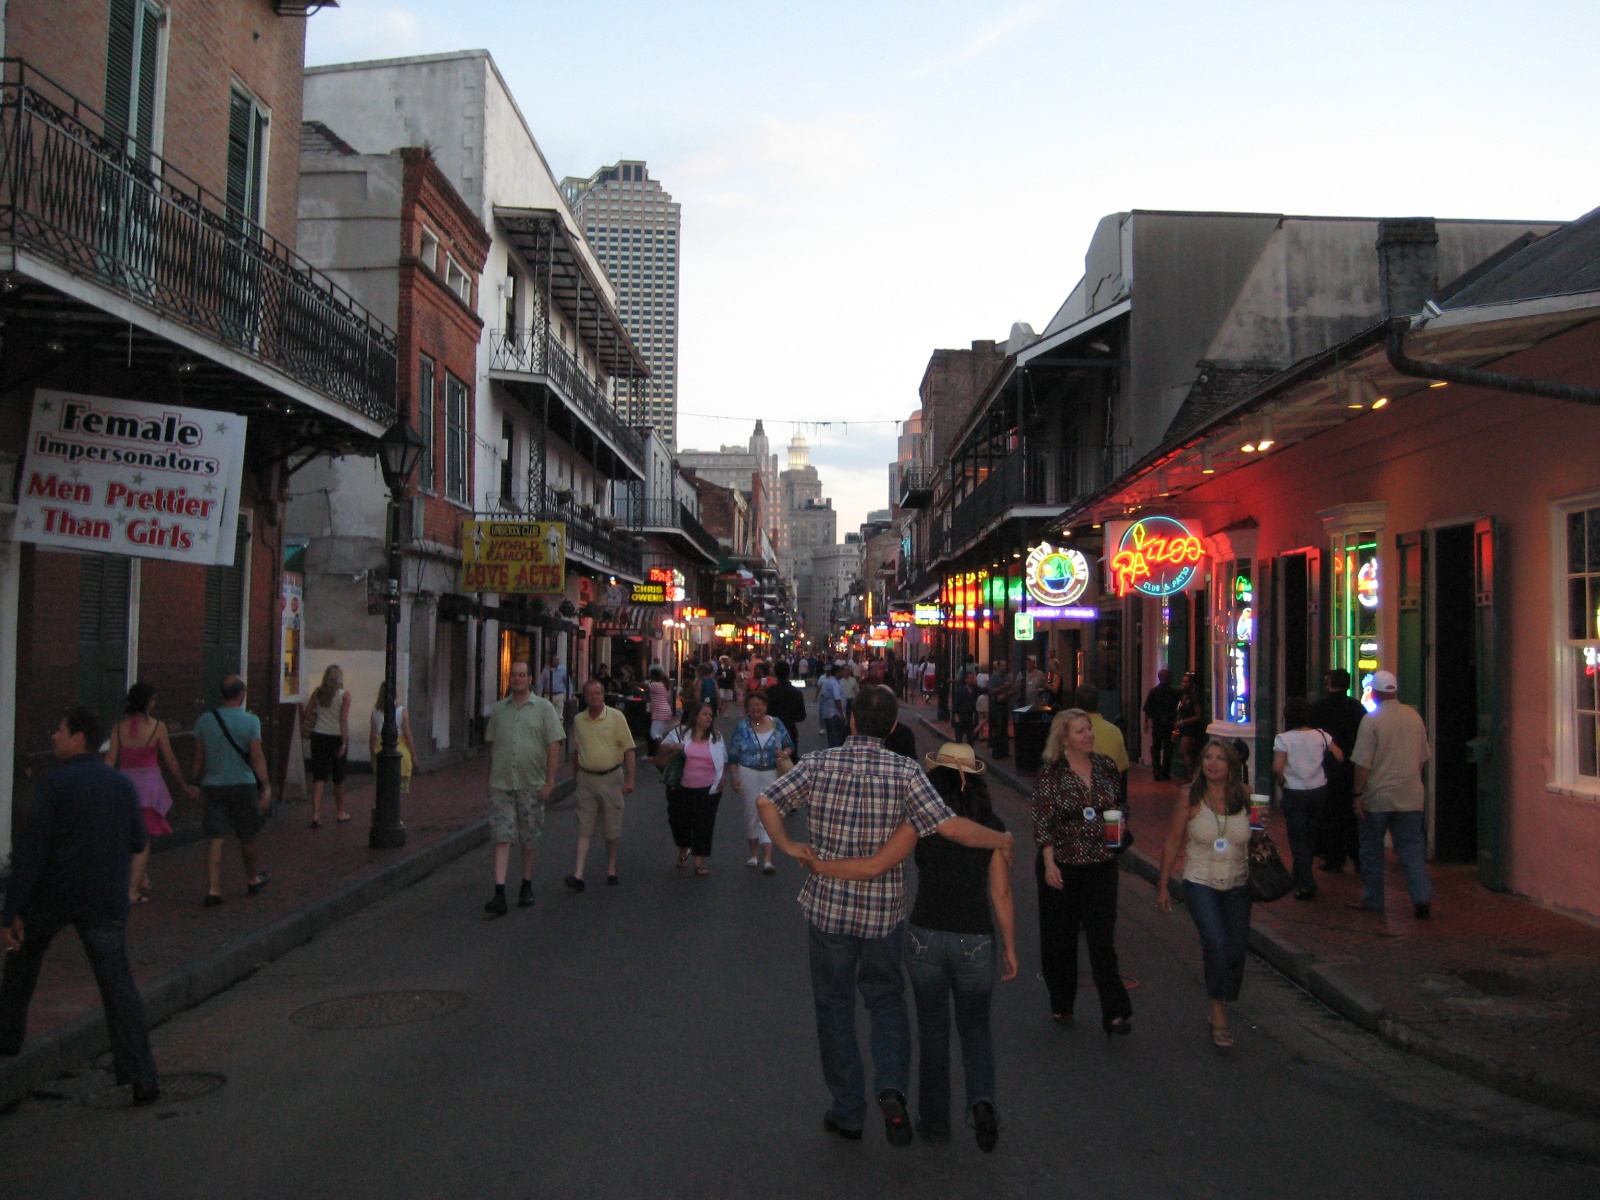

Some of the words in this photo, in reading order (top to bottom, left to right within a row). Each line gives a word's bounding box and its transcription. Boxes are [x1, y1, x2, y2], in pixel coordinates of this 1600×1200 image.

[62, 402, 201, 447] Female
[38, 435, 217, 474] Impersonators
[28, 473, 92, 503] Men
[106, 481, 216, 518] Prettier
[43, 508, 111, 540] Than
[126, 518, 194, 549] Girls
[486, 551, 543, 561] FAMOUS
[491, 540, 539, 550] WORLD
[465, 562, 509, 586] LOVE
[515, 564, 561, 587] ACTS
[1026, 541, 1053, 585] CAJUN
[633, 585, 663, 593] CHRIS
[1143, 582, 1160, 592] CLUB
[1171, 566, 1190, 588] PATIO
[631, 594, 664, 602] OWENS
[1020, 609, 1060, 617] ALCONY
[1064, 609, 1095, 617] DINING
